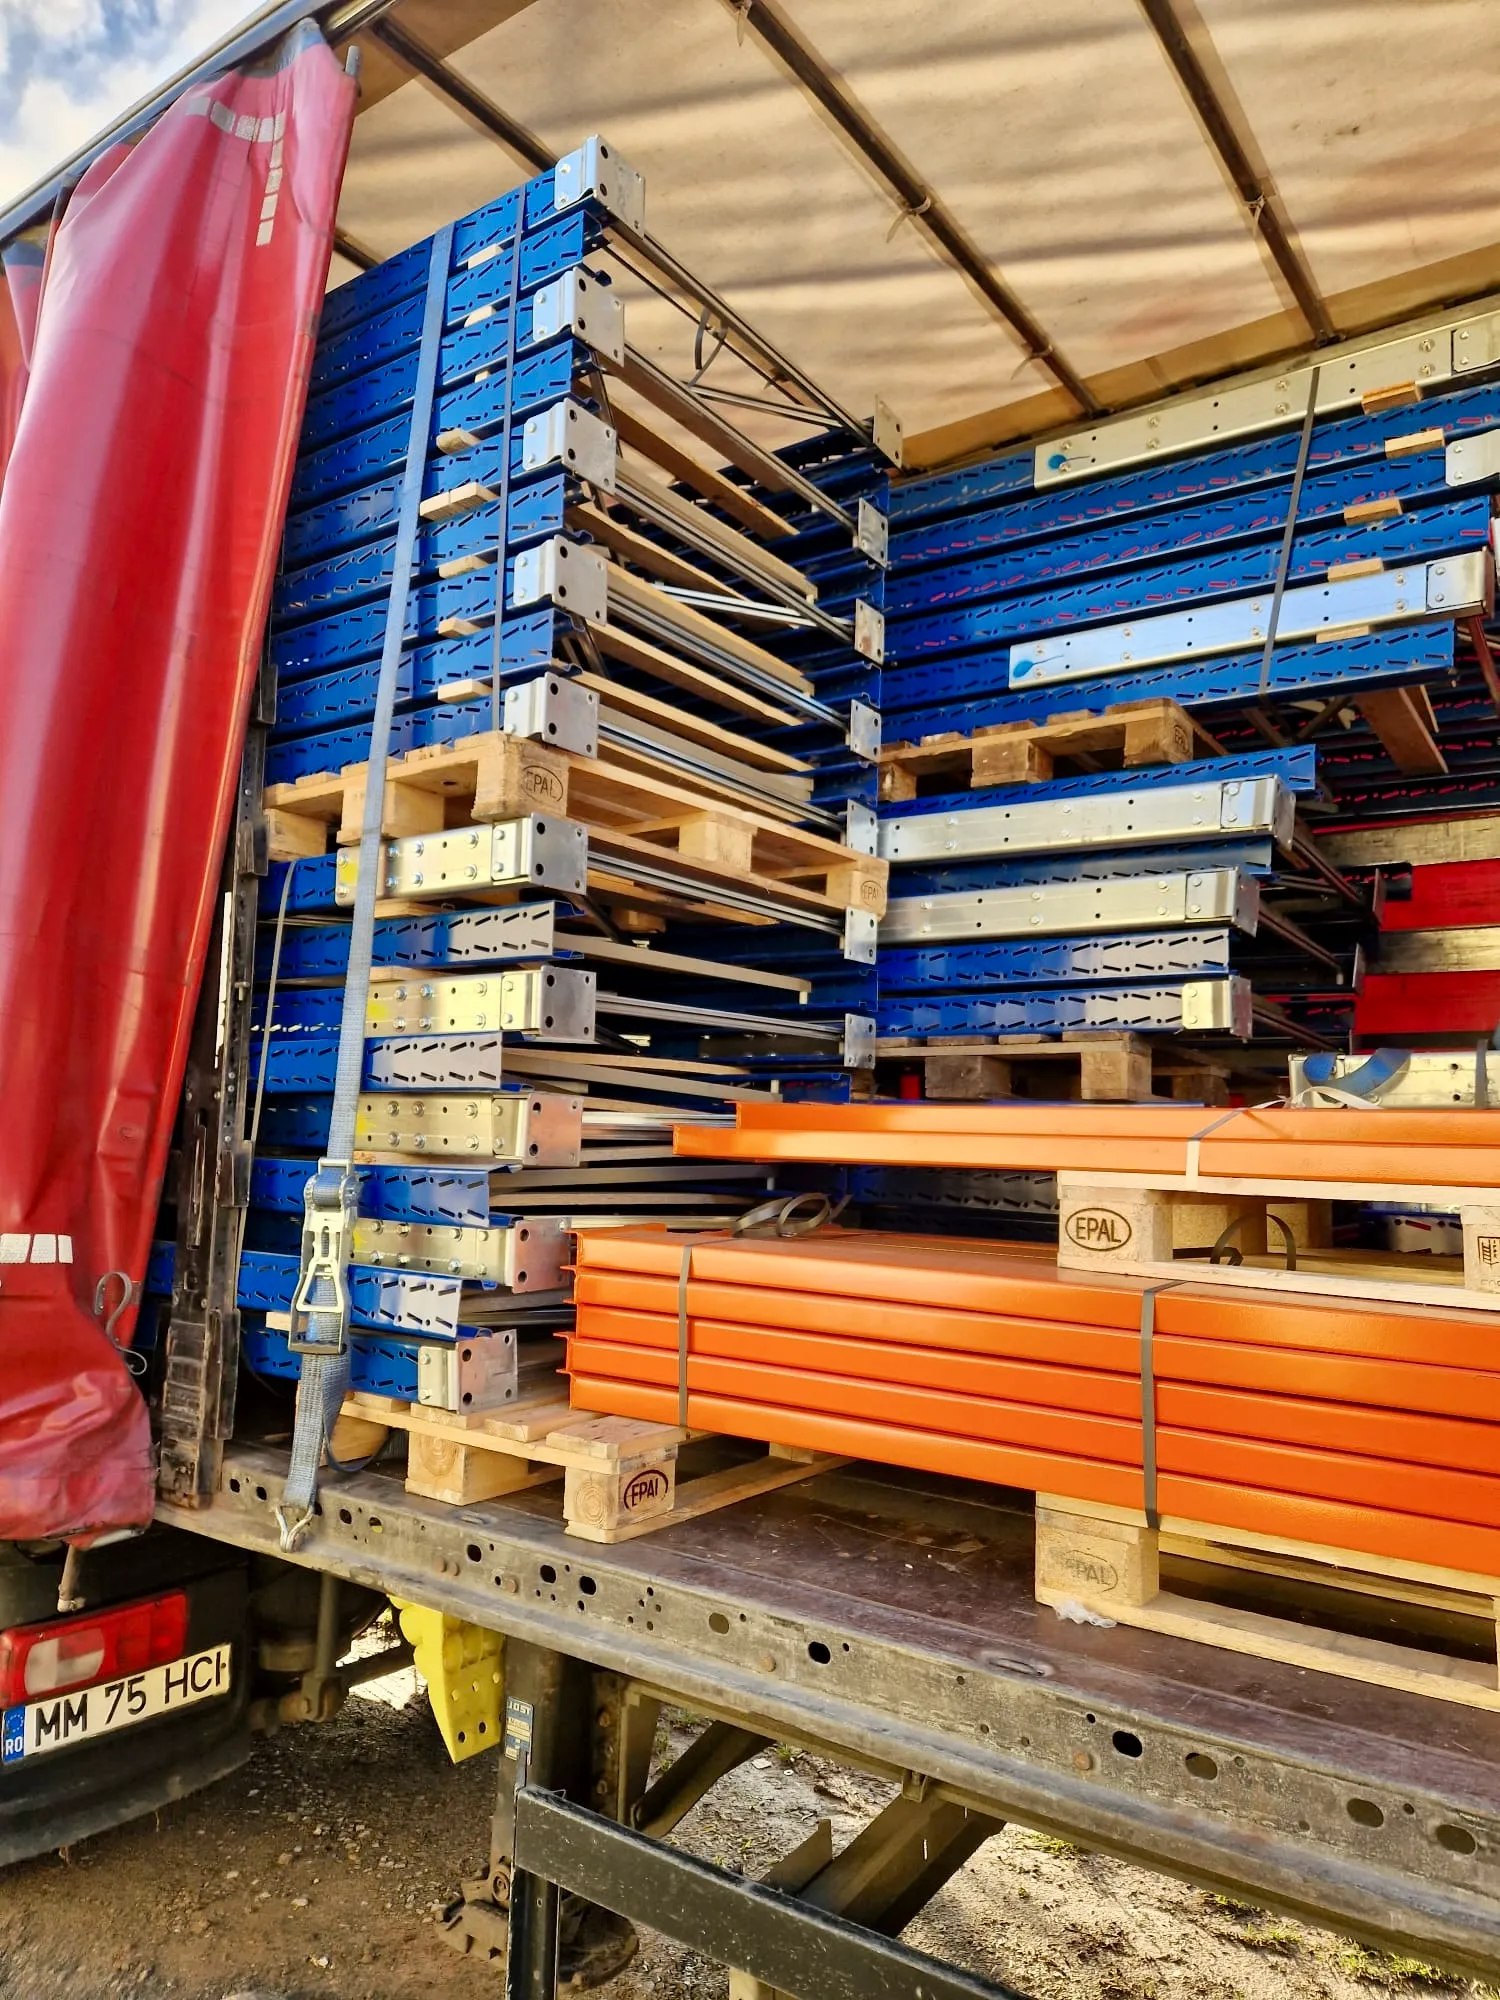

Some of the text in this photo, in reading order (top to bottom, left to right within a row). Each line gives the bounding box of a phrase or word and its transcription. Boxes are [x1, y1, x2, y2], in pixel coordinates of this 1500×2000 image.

[526, 771, 557, 799] EPAL
[1076, 1217, 1122, 1243] EPAL
[36, 1693, 88, 1747] MM
[104, 1676, 147, 1725] 75
[508, 1700, 531, 1716] JOST
[5, 1737, 23, 1755] RO
